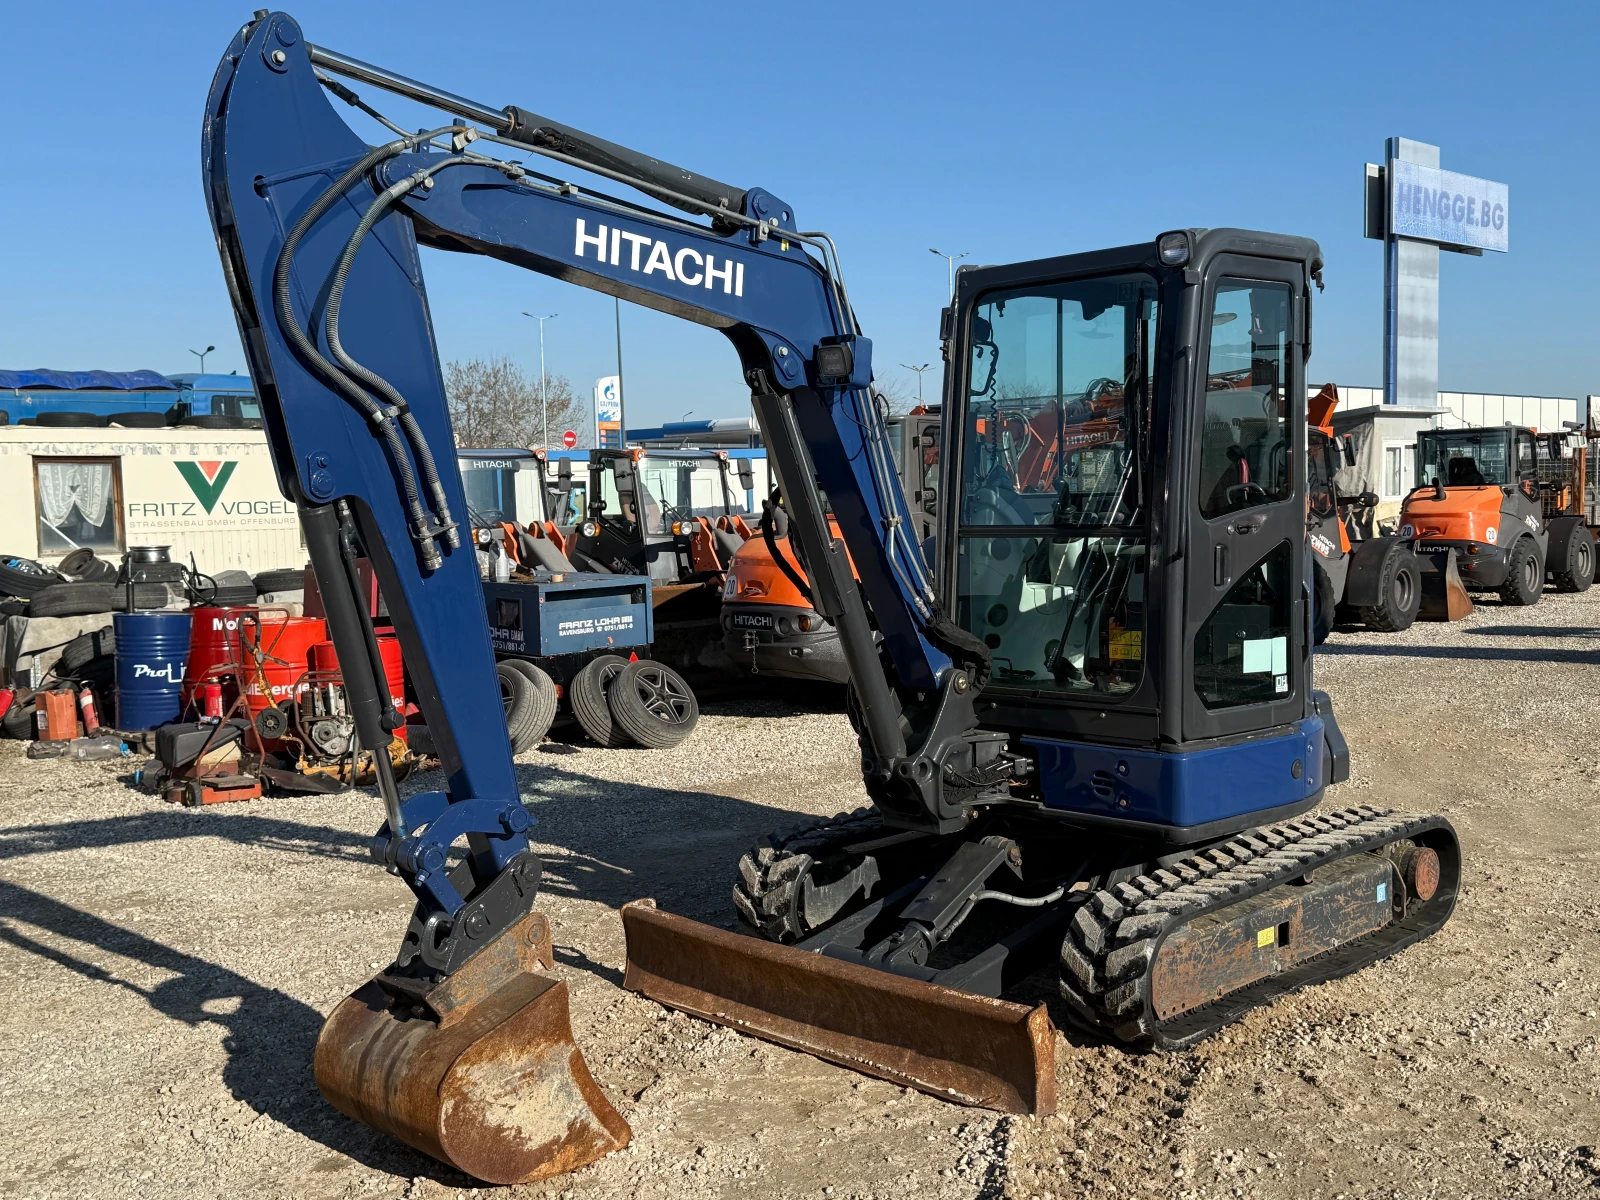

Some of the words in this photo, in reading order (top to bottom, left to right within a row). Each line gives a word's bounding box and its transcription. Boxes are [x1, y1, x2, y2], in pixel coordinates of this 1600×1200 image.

[1398, 182, 1505, 231] HENGGE.BG
[575, 218, 745, 297] HITACHI
[1066, 431, 1110, 446] HITACHI
[473, 460, 512, 469] HITACHI
[668, 460, 701, 468] HITACHI
[128, 502, 197, 517] FRITZ
[220, 501, 295, 515] VOGEL
[129, 519, 204, 528] STRASSENBAU
[240, 517, 296, 525] OFFENBURG
[1402, 526, 1412, 537] 20
[1487, 530, 1495, 541] 20
[725, 579, 736, 595] 20
[558, 619, 593, 630] FRANZ
[594, 616, 620, 626] LOHR
[734, 614, 773, 627] HITACHI
[558, 627, 595, 636] RAVENSBURG
